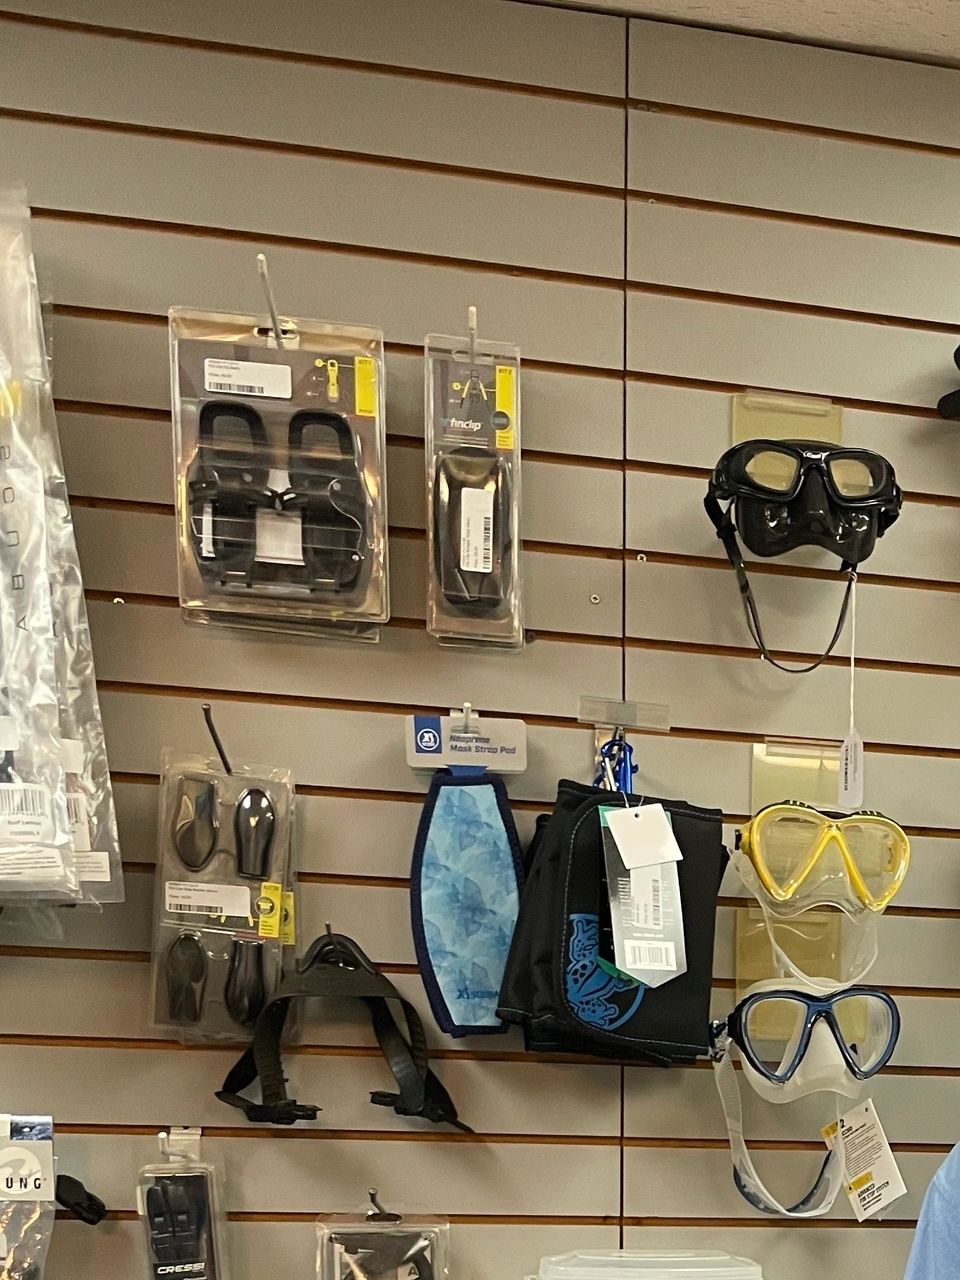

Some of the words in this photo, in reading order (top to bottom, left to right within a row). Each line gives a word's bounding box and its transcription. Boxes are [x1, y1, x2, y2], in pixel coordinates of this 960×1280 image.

[450, 418, 482, 432] finclip
[449, 744, 473, 752] Mask
[474, 746, 498, 754] Strap
[500, 747, 516, 755] Pad
[157, 1262, 205, 1275] CRESSI
